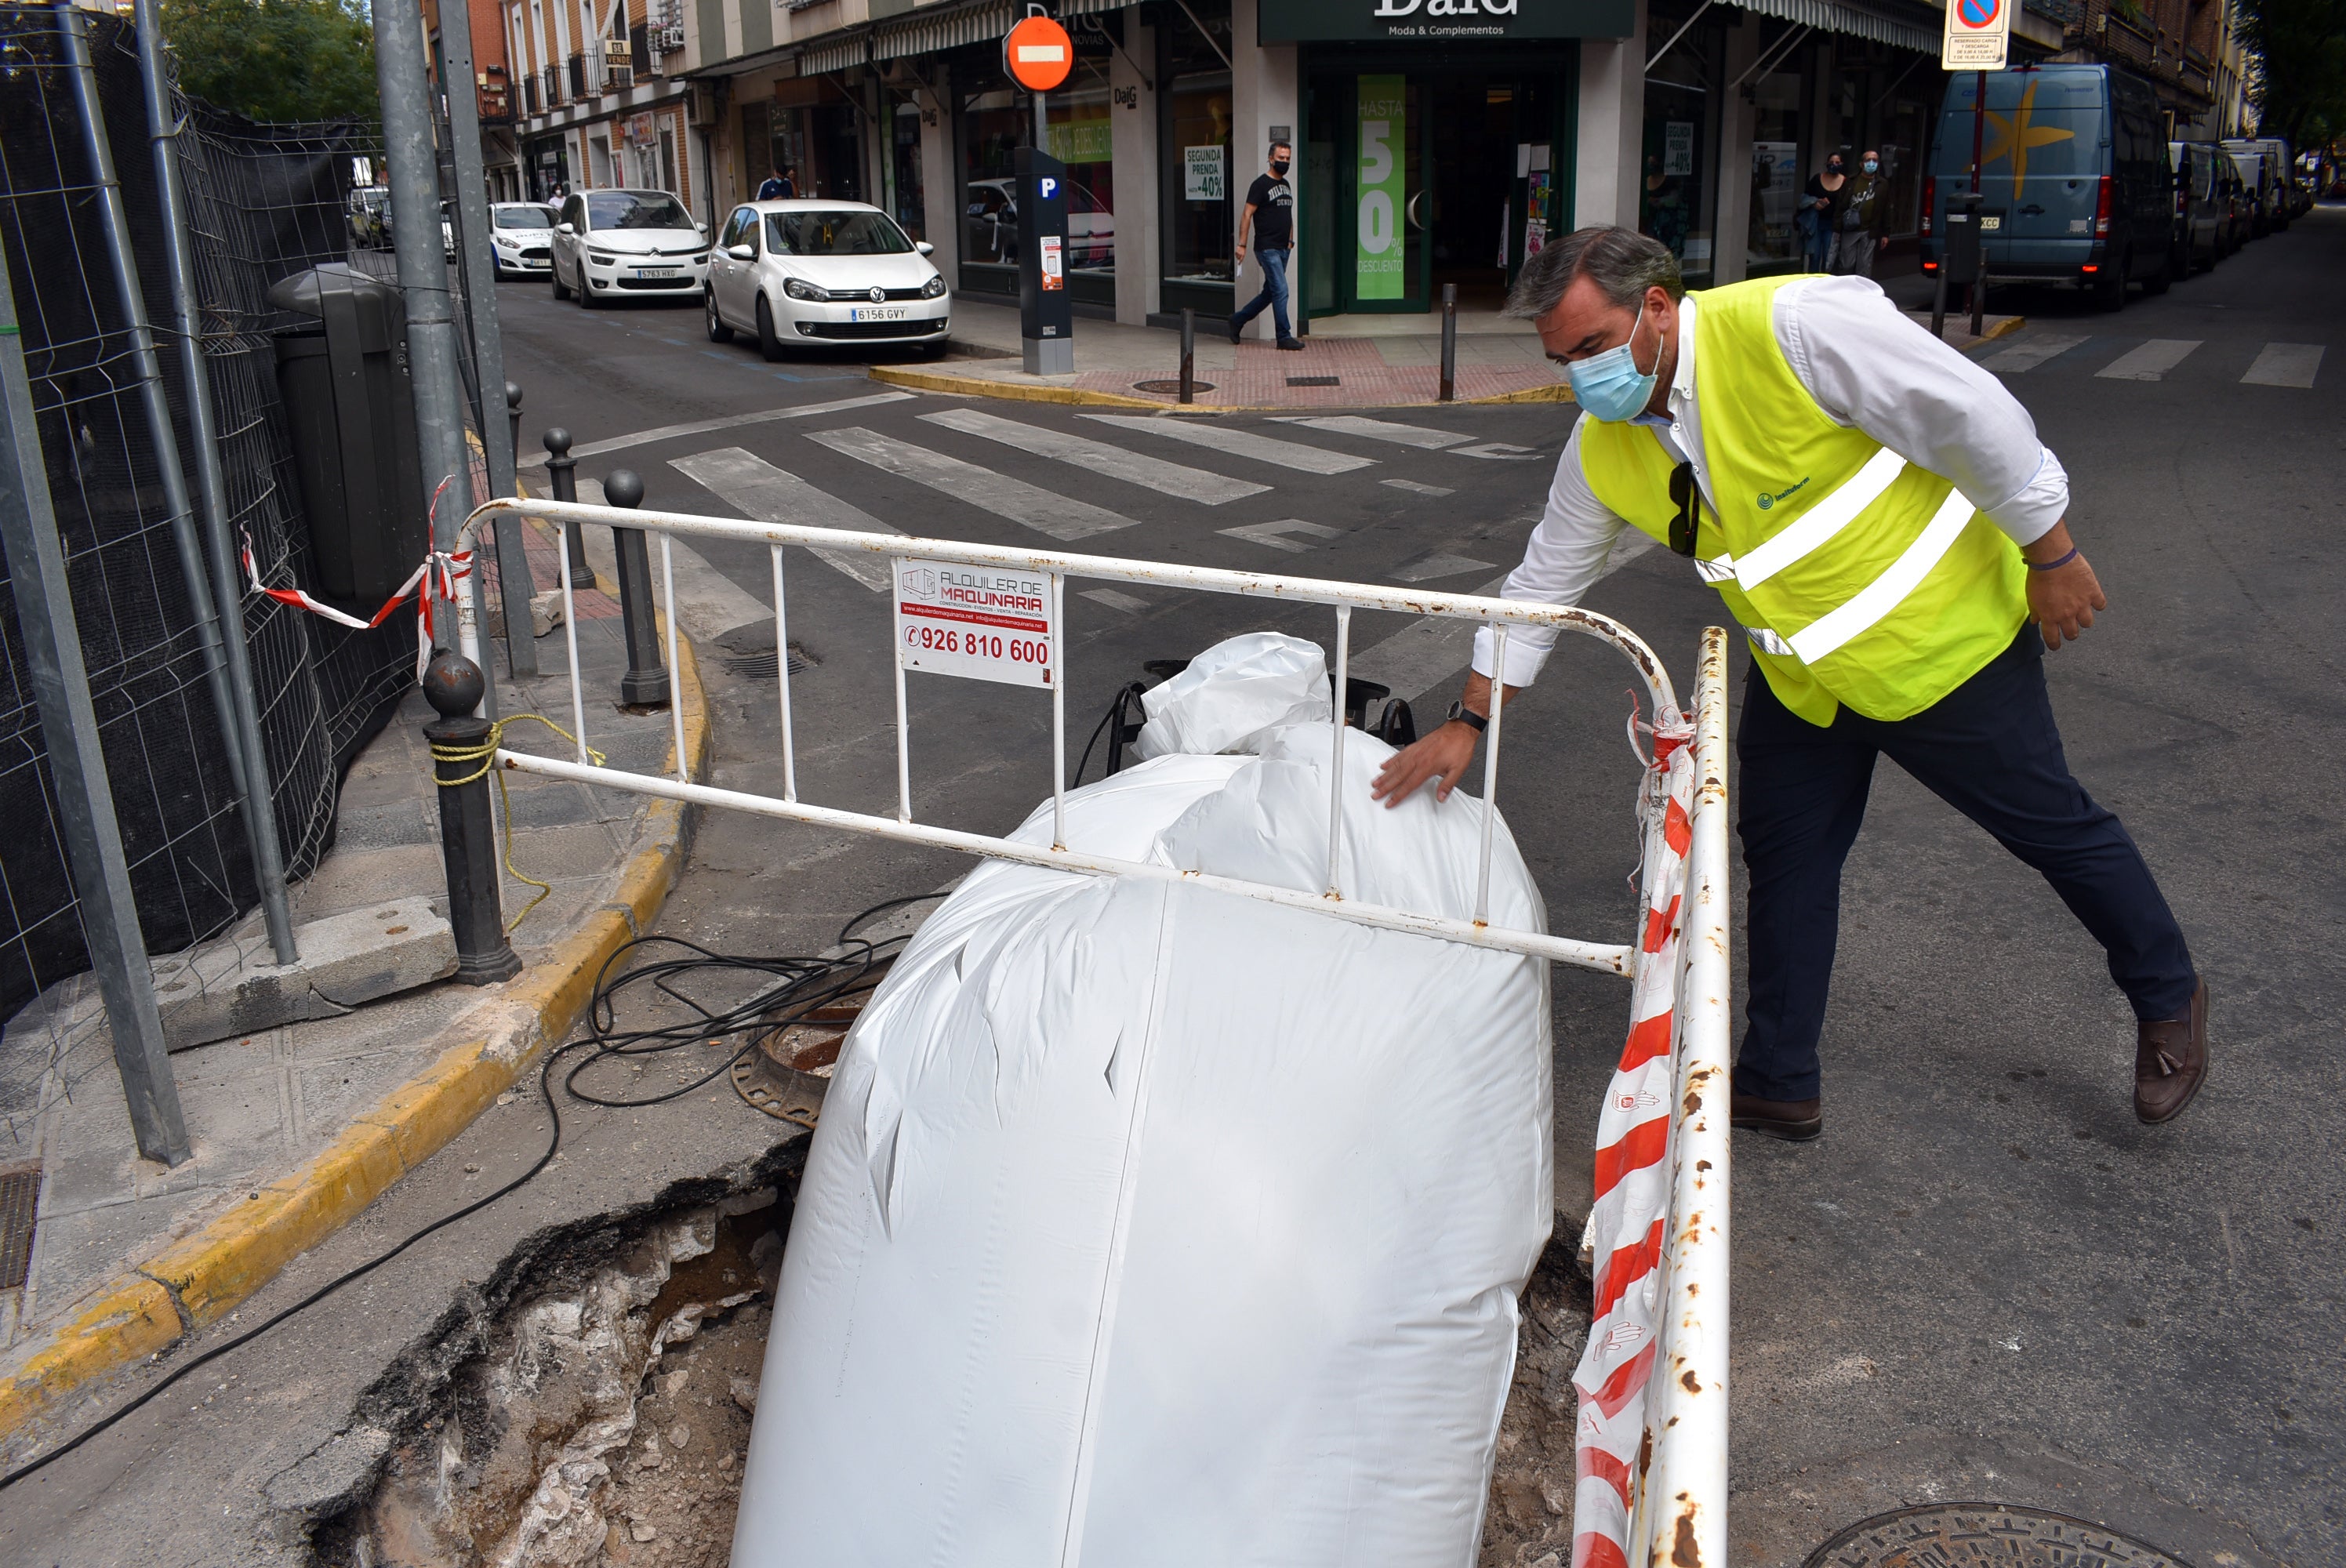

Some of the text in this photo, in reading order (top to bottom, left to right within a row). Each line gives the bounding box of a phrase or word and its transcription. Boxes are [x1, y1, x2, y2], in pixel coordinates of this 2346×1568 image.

[1389, 26, 1504, 37] Moda & Complementos
[1072, 34, 1104, 45] NOVIAS
[613, 44, 622, 53] SE
[607, 56, 630, 64] VENDE
[1114, 86, 1136, 104] DaiG
[1358, 100, 1404, 117] HASTA
[1187, 149, 1222, 162] SEGUNDA
[1192, 163, 1218, 175] PRENDA
[1041, 178, 1056, 198] P
[1198, 176, 1222, 197] -40%
[1358, 260, 1403, 272] DESCUENTO
[859, 309, 906, 320] 6156 GVY
[940, 572, 1043, 596] ALQUILER DE
[940, 586, 1043, 612] MAQUINARIA
[903, 605, 1043, 629] www.alquilerdemaquinaria.net info@alquilerdemaquinaria.net
[921, 626, 1048, 665] 926 810 600
